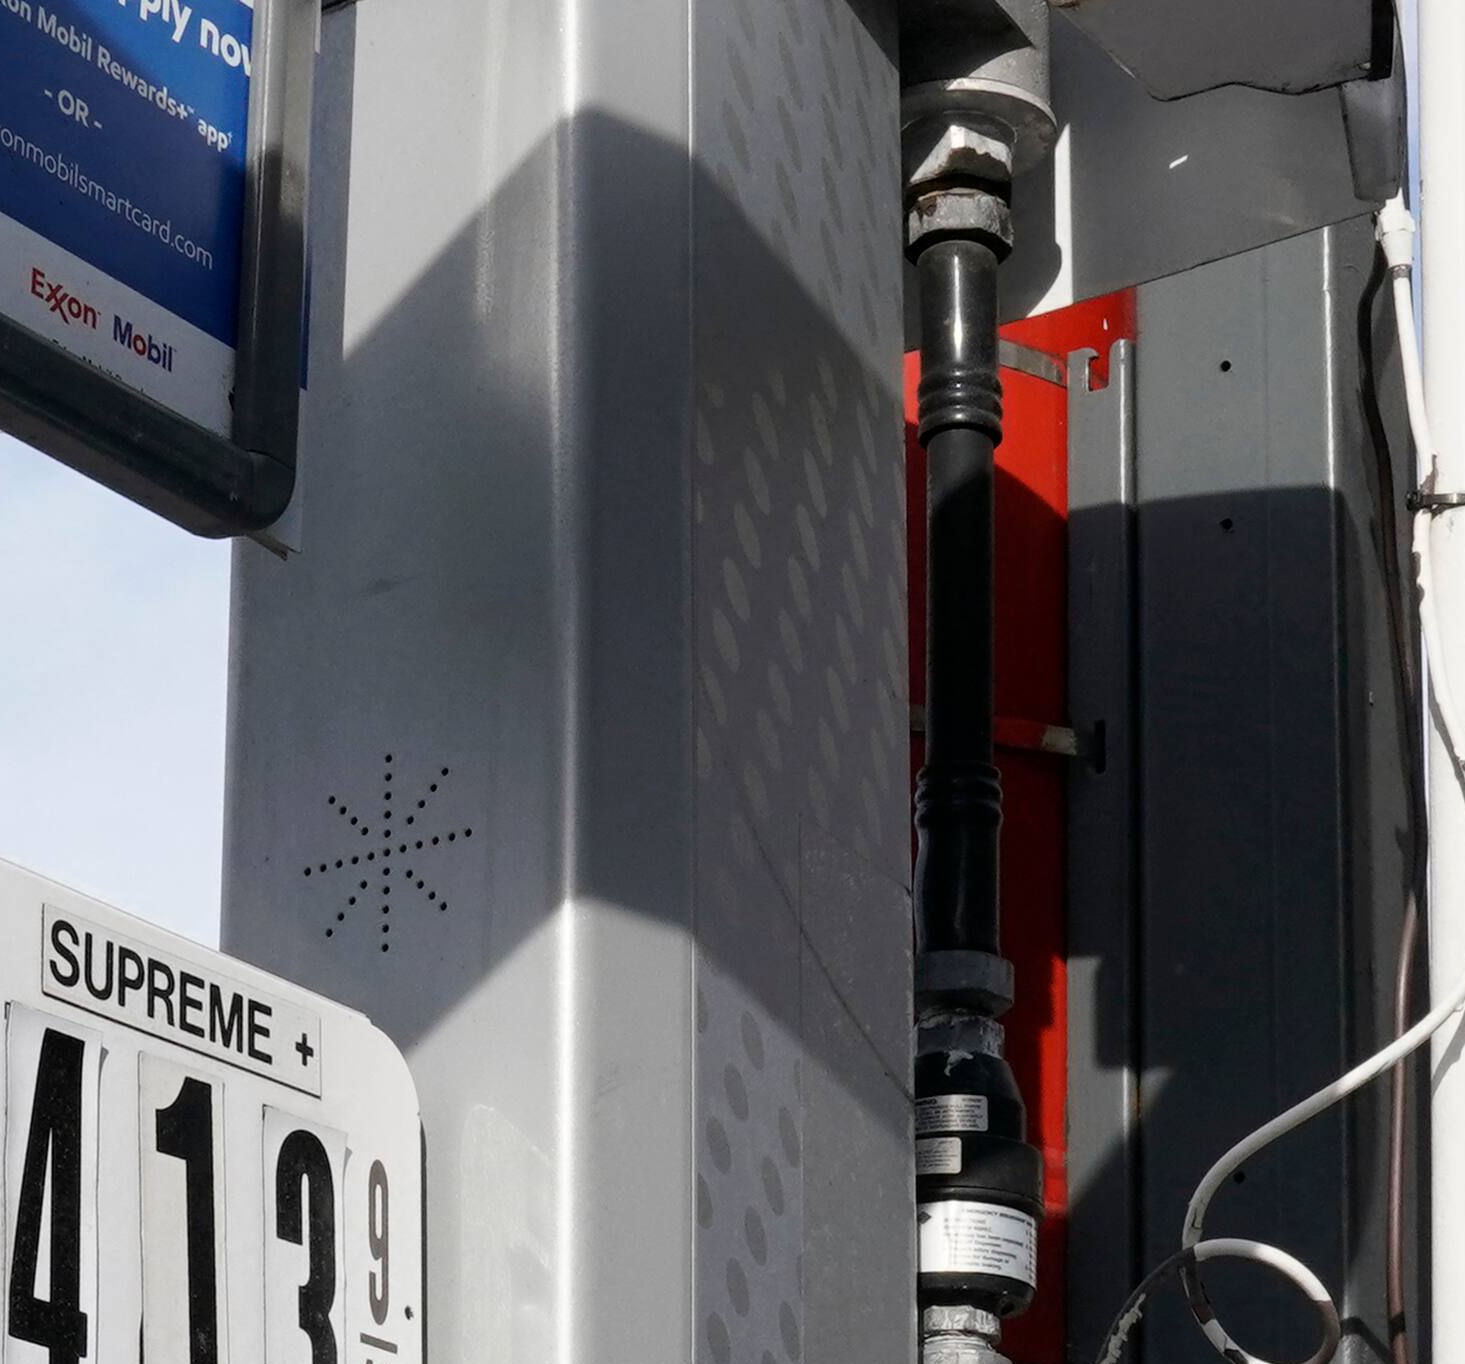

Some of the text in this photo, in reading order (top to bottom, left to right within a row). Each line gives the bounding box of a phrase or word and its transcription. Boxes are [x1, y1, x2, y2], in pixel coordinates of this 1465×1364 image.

[38, 6, 92, 60] Mobil
[118, 0, 192, 43] ply
[58, 88, 90, 128] OR
[30, 267, 99, 330] Exxon
[113, 314, 174, 372] Mobil
[49, 919, 273, 1064] SUPREME
